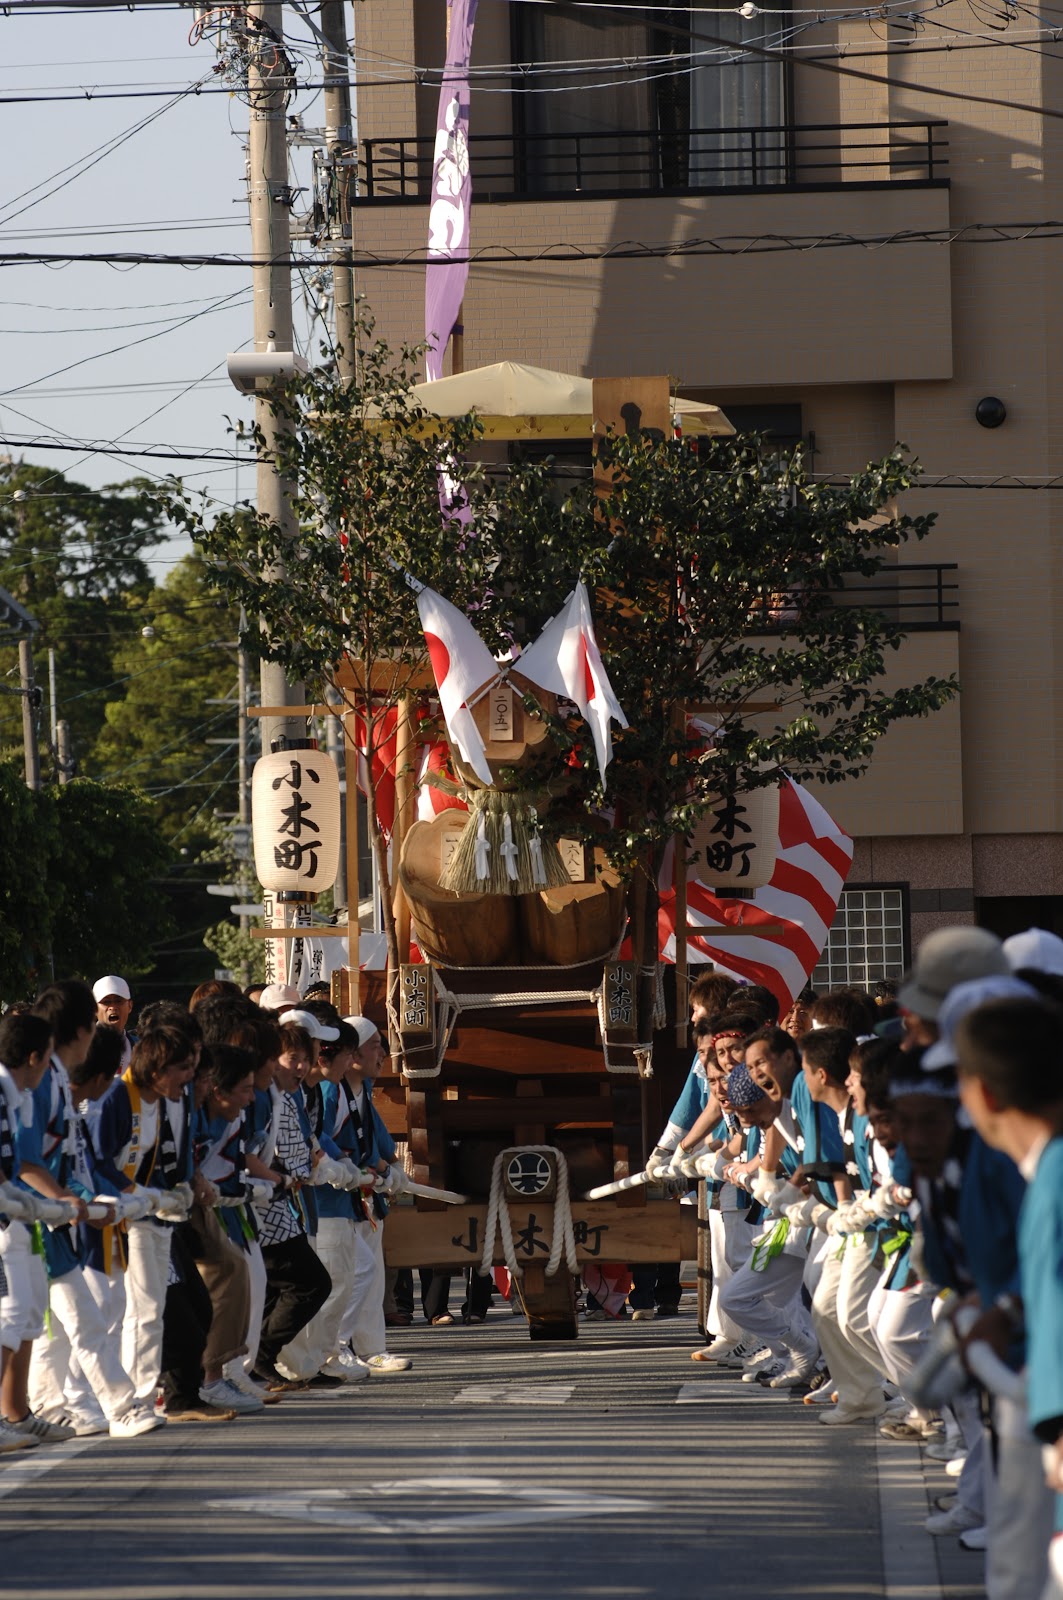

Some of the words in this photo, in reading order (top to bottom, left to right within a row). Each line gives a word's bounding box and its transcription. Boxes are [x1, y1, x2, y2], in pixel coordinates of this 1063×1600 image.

[271, 759, 323, 878] 小木町
[705, 768, 757, 877] 木町
[404, 970, 427, 1027] 小木町
[608, 966, 631, 1024] 小木町
[451, 1213, 610, 1256] 小木町
